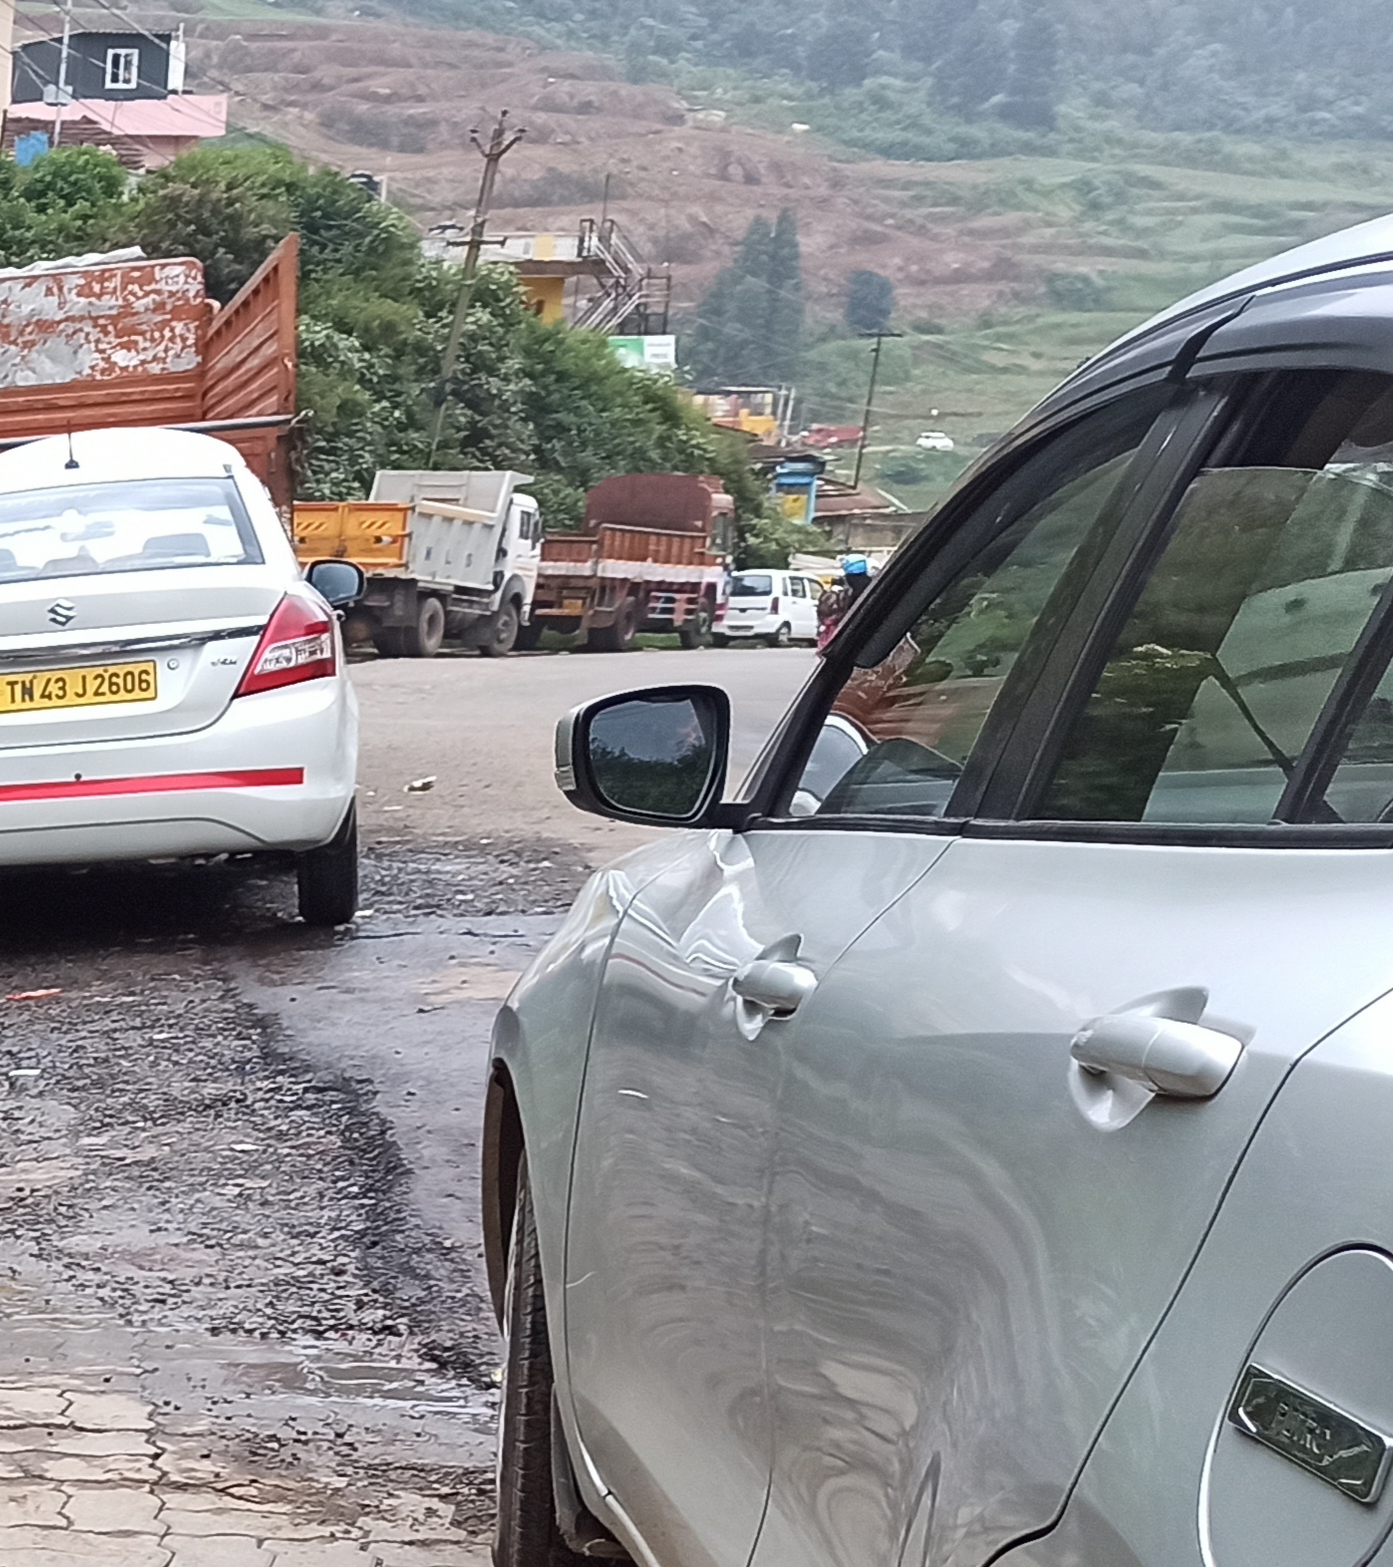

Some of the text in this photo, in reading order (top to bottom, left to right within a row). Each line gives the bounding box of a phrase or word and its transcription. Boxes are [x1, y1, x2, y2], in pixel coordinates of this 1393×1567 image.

[5, 669, 152, 704] TN 43 J 2606
